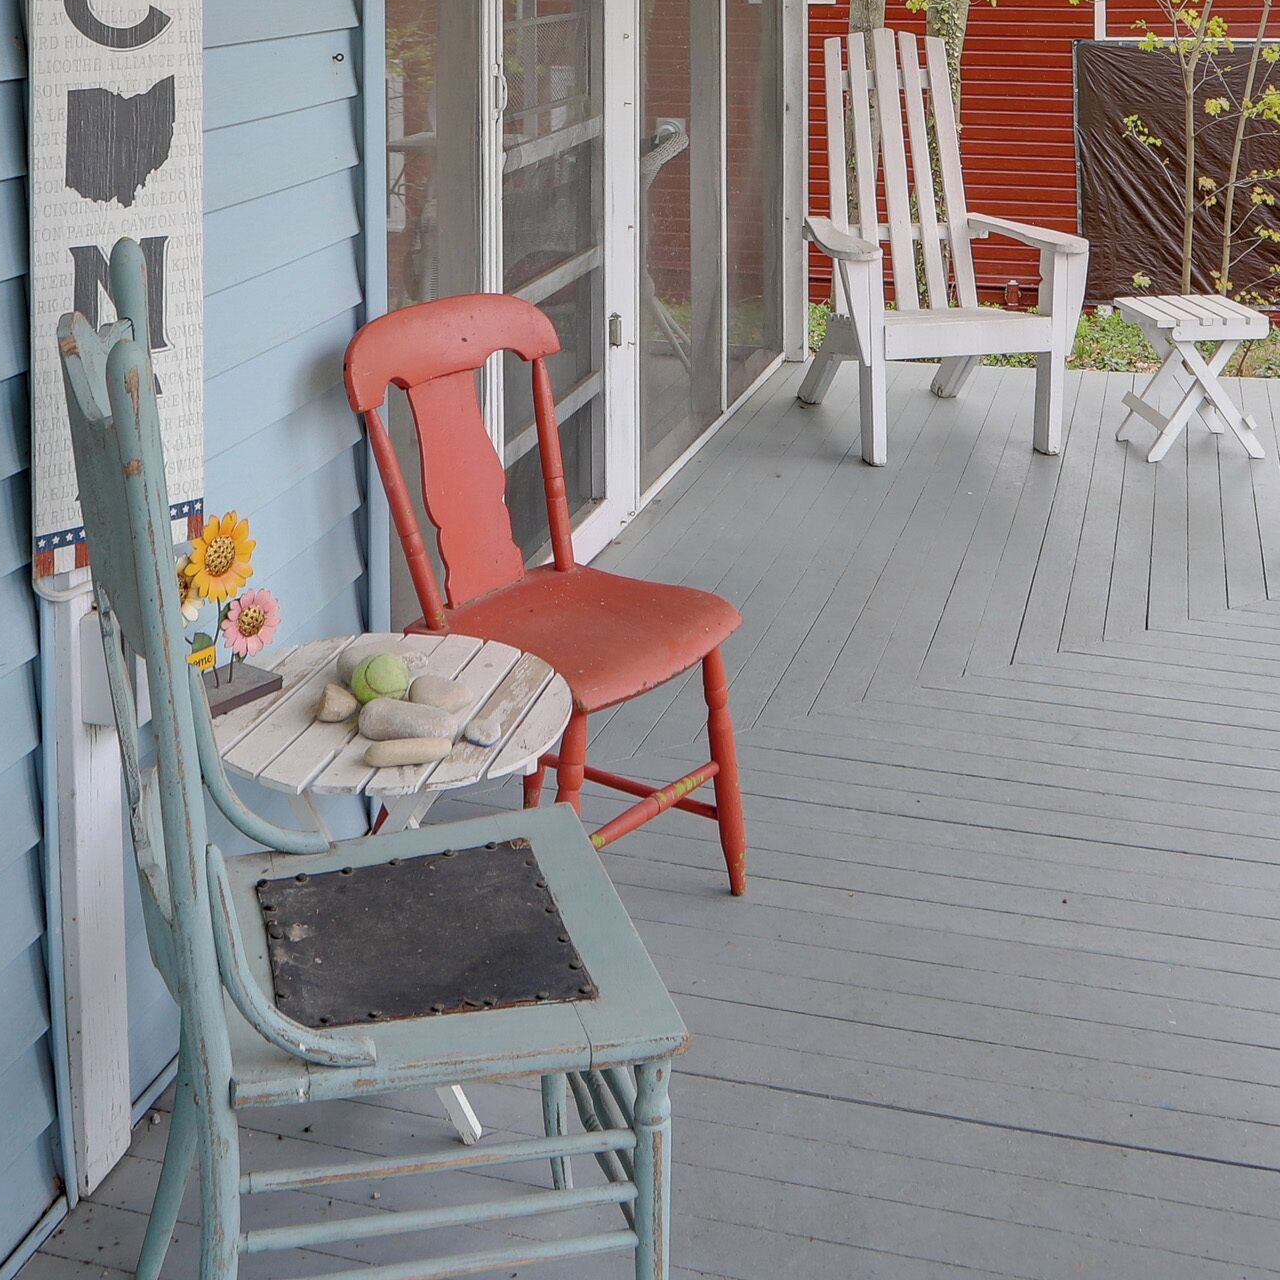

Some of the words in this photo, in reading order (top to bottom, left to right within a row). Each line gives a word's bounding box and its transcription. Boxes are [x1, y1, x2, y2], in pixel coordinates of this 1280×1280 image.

[107, 53, 176, 71] ALLIANCE
[67, 222, 116, 240] PARMA
[120, 213, 176, 232] CANTON
